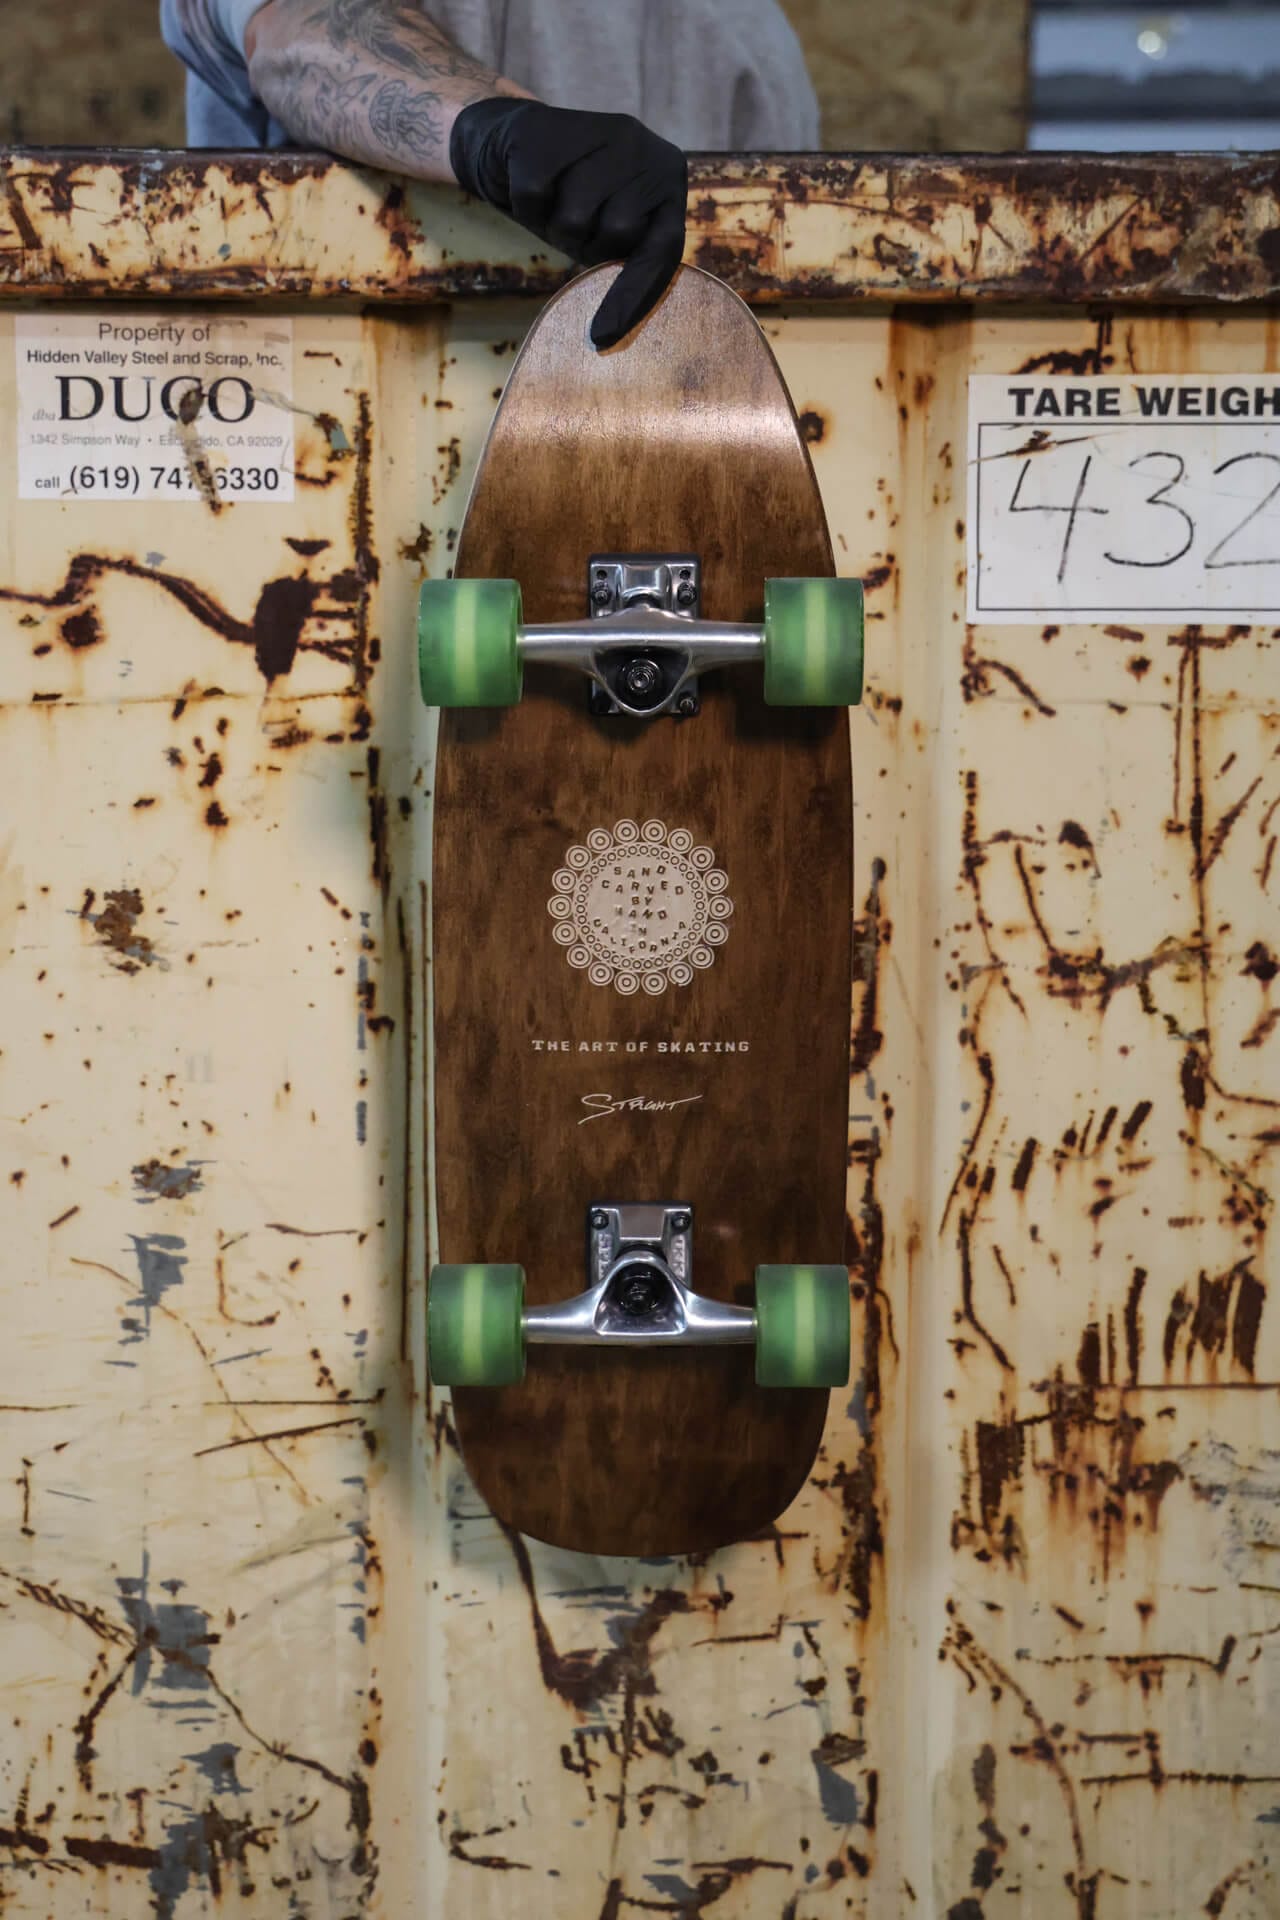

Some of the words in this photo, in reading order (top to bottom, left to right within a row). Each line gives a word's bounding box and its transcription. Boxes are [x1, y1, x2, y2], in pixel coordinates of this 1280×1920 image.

[99, 323, 185, 345] Property
[192, 323, 211, 341] of
[27, 350, 80, 364] Hidden
[84, 350, 128, 367] Valley
[131, 351, 169, 365] Steel
[172, 351, 200, 365] and
[204, 351, 253, 369] Scrap,
[55, 375, 255, 423] DUCO
[1008, 387, 1121, 417] TARE
[1136, 386, 1280, 417] WEIGH
[61, 433, 112, 448] Simpson
[114, 434, 141, 449] Way
[226, 434, 245, 447] CA
[247, 435, 284, 448] 92029
[35, 475, 60, 489] call
[69, 464, 141, 495] (619)
[1009, 451, 1280, 584] 432
[613, 864, 667, 880] SAND
[601, 879, 685, 896] CARVED
[631, 896, 653, 906] BY
[614, 905, 669, 921] HAND
[593, 918, 688, 955] CALIFORNIA
[531, 1039, 570, 1052] THE
[578, 1040, 619, 1053] ART
[625, 1041, 649, 1053] OF
[657, 1040, 750, 1054] SKATING
